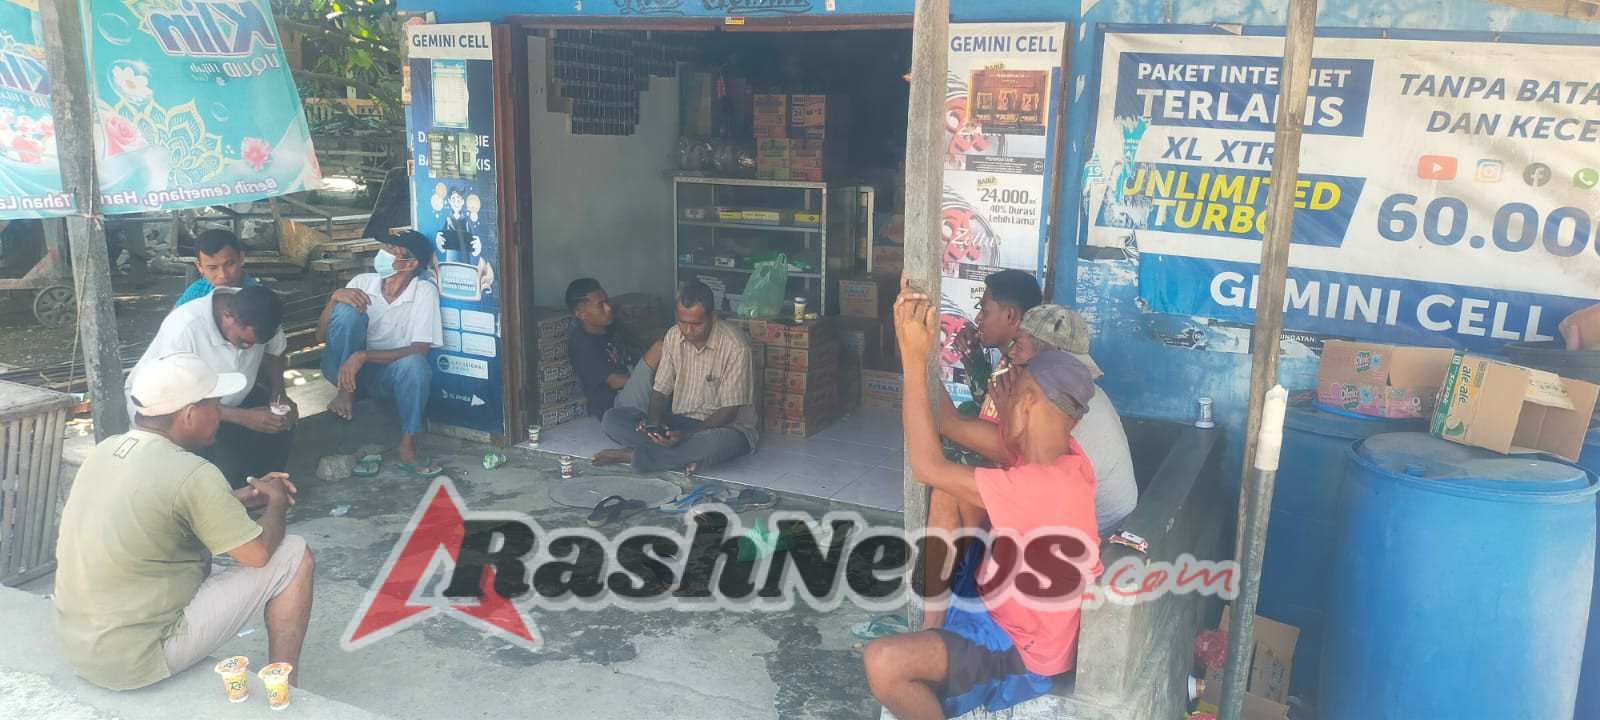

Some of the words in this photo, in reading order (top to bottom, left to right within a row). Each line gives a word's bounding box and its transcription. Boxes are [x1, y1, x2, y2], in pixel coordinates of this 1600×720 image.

[412, 34, 456, 48] GEMINI
[458, 35, 489, 49] CELL
[950, 36, 1011, 53] GEMINI
[1015, 36, 1057, 53] CELL
[1137, 62, 1215, 83] PAKET
[1220, 66, 1351, 88] INTENET
[1400, 73, 1506, 101] TANPA
[1136, 88, 1345, 127] TERLAIS
[1426, 110, 1501, 136] DAN
[1161, 136, 1204, 161] XL
[1213, 139, 1276, 166] XTR
[981, 187, 1029, 205] 24.000
[989, 215, 1010, 224] Lebih
[1009, 205, 1036, 216] Durasi
[1377, 193, 1600, 257] 60.00
[1416, 294, 1554, 342] CELL
